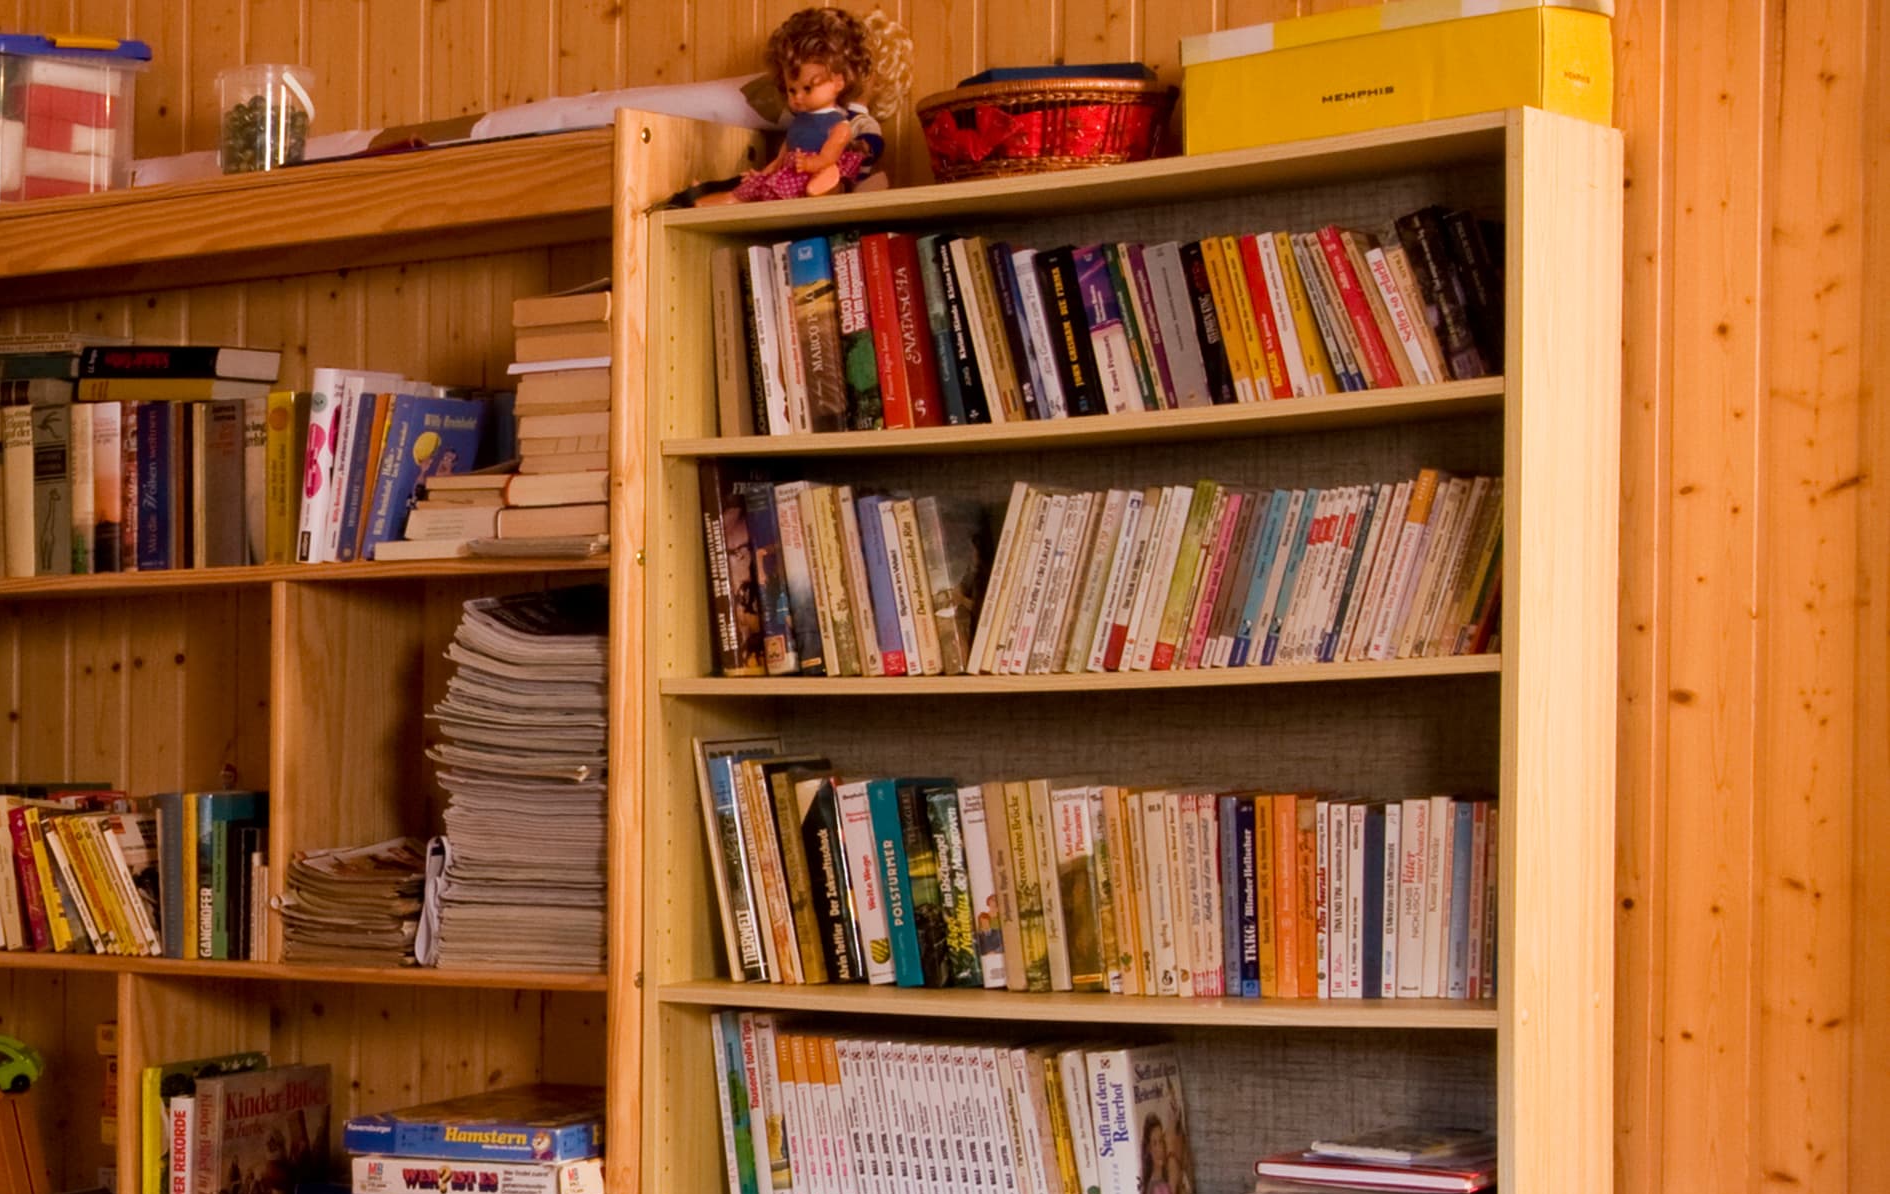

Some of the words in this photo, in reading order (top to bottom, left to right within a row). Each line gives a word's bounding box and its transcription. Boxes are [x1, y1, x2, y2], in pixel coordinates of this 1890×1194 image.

[1320, 86, 1395, 106] MEMPHIS
[833, 251, 850, 298] Mendes
[846, 248, 862, 297] Regenwald
[944, 272, 957, 299] Kleine
[1051, 267, 1065, 296] FIRMA
[1371, 258, 1396, 294] gelacht
[837, 300, 854, 334] Chico
[851, 300, 863, 312] im
[895, 267, 922, 364] NATASCHA
[1057, 299, 1070, 316] DIE
[1391, 295, 1401, 308] so
[853, 314, 867, 330] Tod
[1396, 309, 1413, 344] Selten
[807, 326, 824, 372] MARCO
[955, 332, 968, 359] Kleine
[1063, 320, 1079, 361] GRISHAM
[1071, 363, 1086, 388] JOHN
[947, 807, 964, 871] Mangroven
[1013, 831, 1024, 857] ohne
[861, 854, 873, 882] Wege
[1016, 857, 1030, 889] Strom
[1402, 850, 1416, 885] Vater
[829, 900, 841, 917] Der
[1244, 878, 1255, 917] Blinder
[200, 887, 213, 957] GANGHOFER
[736, 909, 757, 965] TIERWELT
[834, 922, 848, 953] Toffler
[1244, 924, 1257, 964] TKKG
[839, 955, 851, 980] Alvin
[741, 1019, 752, 1041] Tips
[742, 1042, 755, 1065] tolle
[747, 1066, 760, 1110] Tausend
[1094, 1073, 1108, 1100] dem
[1096, 1102, 1110, 1122] auf
[1109, 1081, 1130, 1144] Reiterhof
[174, 1110, 187, 1172] REKORDE
[444, 1126, 528, 1146] Hamstern
[1098, 1123, 1116, 1158] Steffi
[368, 1162, 383, 1175] MB
